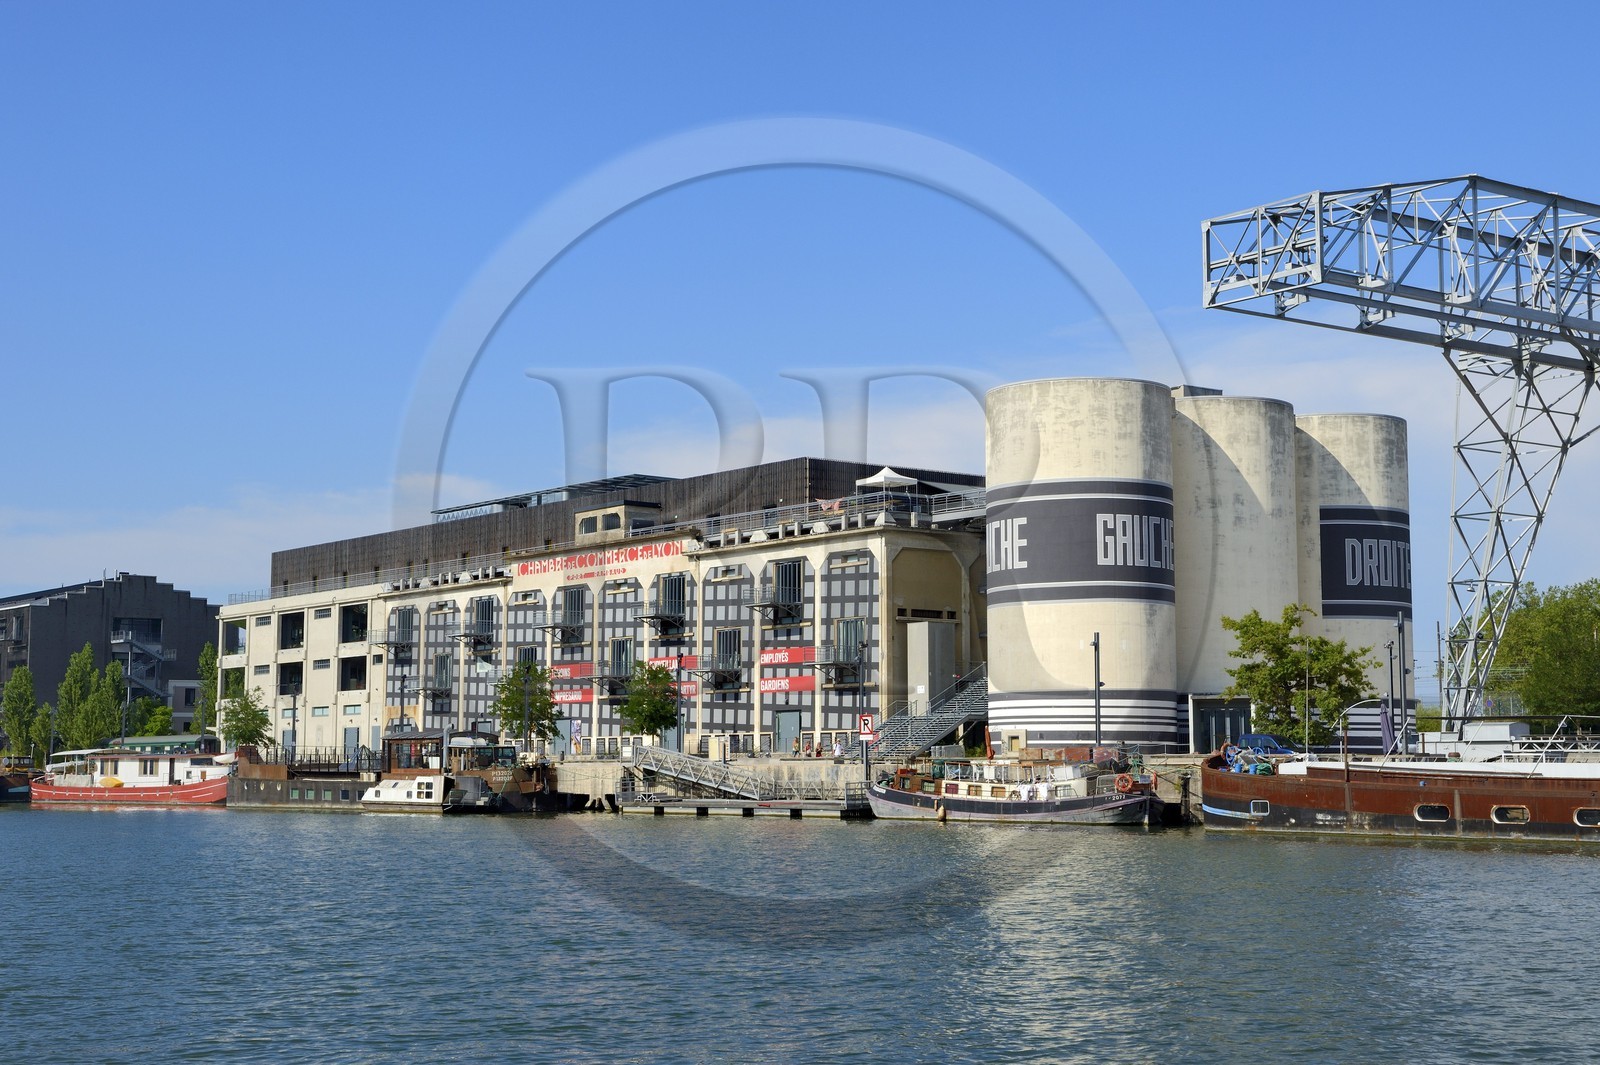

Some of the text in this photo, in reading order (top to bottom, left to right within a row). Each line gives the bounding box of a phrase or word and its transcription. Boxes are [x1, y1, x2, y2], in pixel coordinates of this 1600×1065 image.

[518, 541, 681, 577] CHAMBRE DE COMMERCE DE LYON
[986, 517, 1028, 574] UCHE
[1096, 513, 1174, 571] GAUCHE
[1344, 538, 1412, 590] DROITE
[761, 650, 788, 664] EMPLOYÉS
[761, 679, 789, 691] GARDIENS
